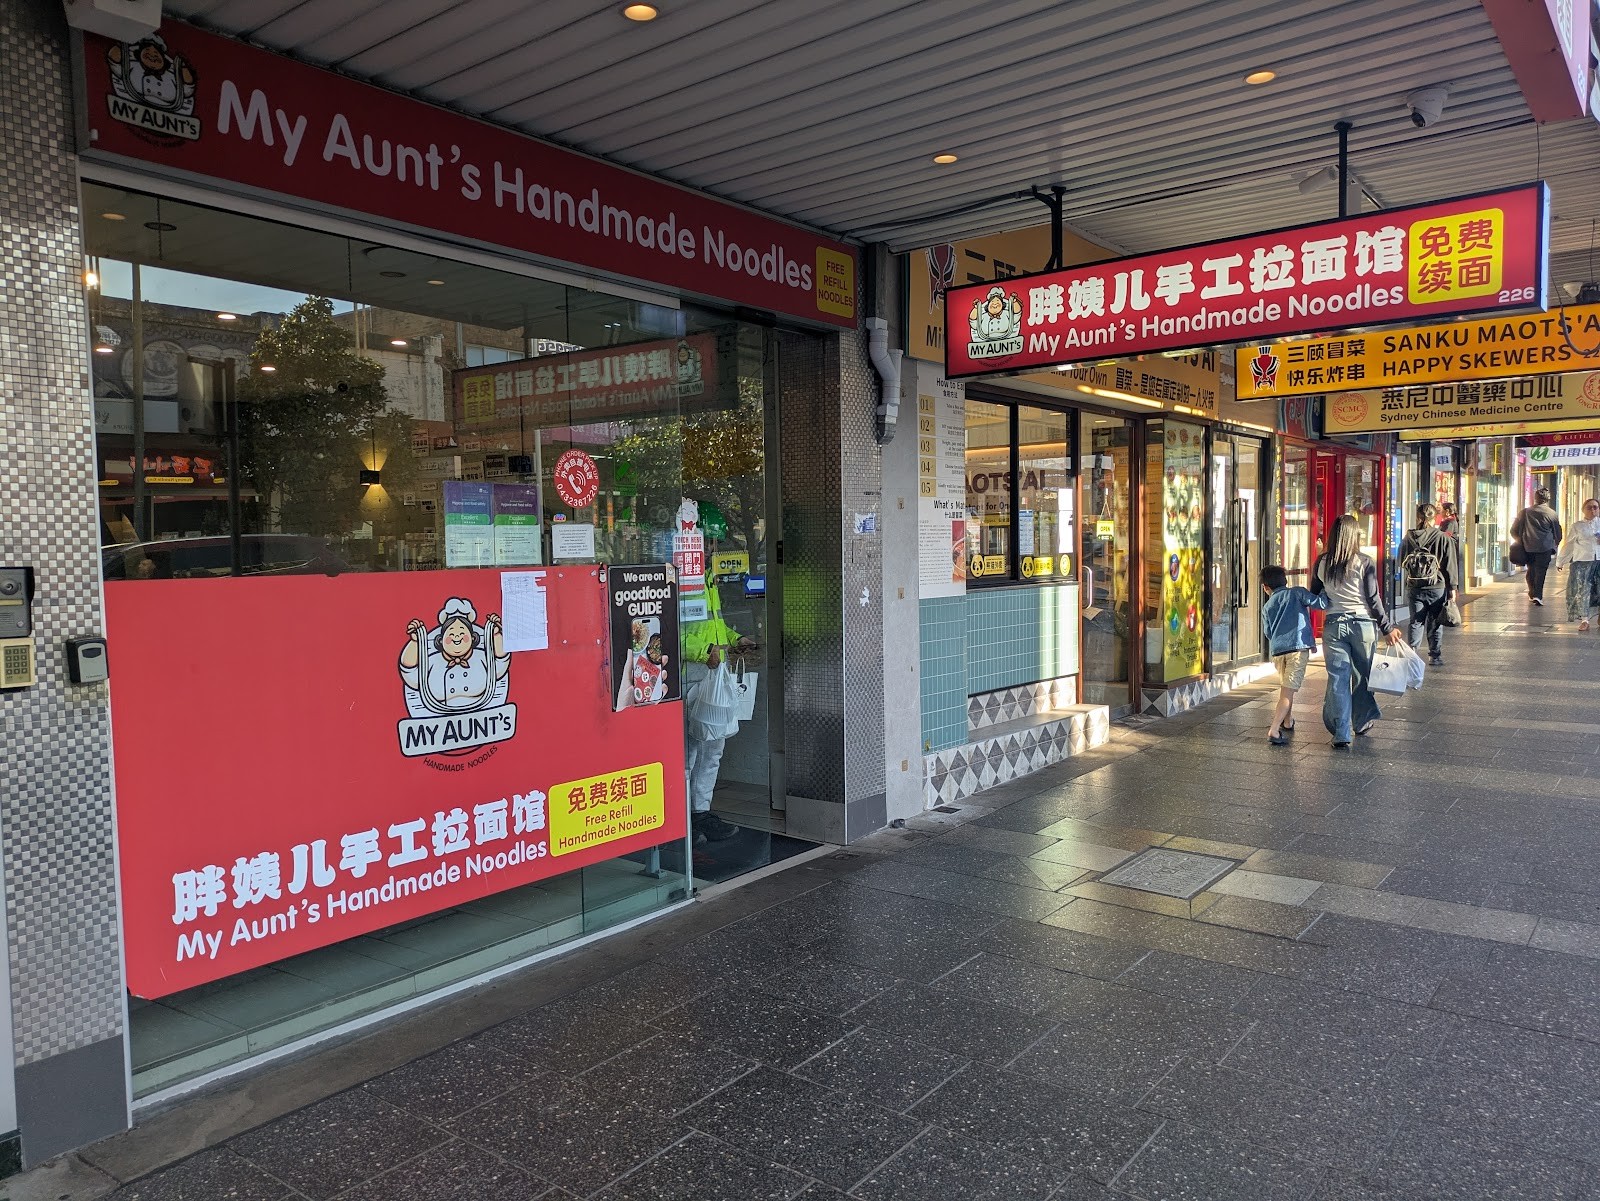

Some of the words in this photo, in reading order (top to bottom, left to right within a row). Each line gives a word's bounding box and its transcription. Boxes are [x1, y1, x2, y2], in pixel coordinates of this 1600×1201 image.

[112, 100, 138, 121] MY
[217, 80, 308, 166] My
[323, 113, 482, 201] Aunt's
[494, 161, 696, 259] Handmade
[703, 225, 813, 291] Noodles
[1418, 219, 1494, 260] 免费
[826, 260, 845, 276] FREE
[1028, 225, 1407, 326] 胖姨儿手工拉面馆
[1417, 255, 1492, 295] 续面
[823, 275, 849, 291] REFILL
[818, 289, 853, 307] NOODLES
[1498, 286, 1535, 303] 226
[1028, 333, 1060, 356] My
[1065, 318, 1136, 348] Aunt's
[1142, 299, 1281, 339] Handmade
[1289, 283, 1404, 319] Noodles
[970, 344, 986, 356] MY
[1287, 339, 1366, 364] 三顾冒菜
[1383, 328, 1469, 354] SANKU
[1382, 354, 1453, 377] HAPPY
[1459, 344, 1571, 369] SKEWERS
[936, 377, 949, 388] How
[1089, 366, 1107, 386] Own
[1287, 364, 1366, 387] 快乐炸串
[921, 399, 929, 410] 01
[1338, 405, 1362, 413] SCMC
[1381, 412, 1419, 423] Sydney
[1423, 409, 1466, 419] Chinese
[1470, 405, 1520, 416] Medicine
[1524, 402, 1563, 412] Centre
[921, 420, 930, 431] 02
[921, 441, 930, 452] 03
[555, 455, 567, 477] PHONE
[567, 450, 585, 459] ORDER
[585, 455, 595, 471] PICK
[592, 471, 599, 480] UP
[921, 461, 930, 473] 04
[556, 484, 598, 507] 0432367226
[921, 482, 931, 493] 05
[720, 559, 742, 570] OPEN
[624, 572, 637, 583] We
[637, 573, 652, 583] are
[654, 572, 664, 582] on
[615, 585, 671, 606] goodfood
[628, 601, 662, 616] GUIDE
[406, 724, 438, 749] MY
[423, 756, 465, 772] HANDMADE
[467, 744, 498, 769] NOODLES
[568, 773, 648, 815] 免费续面
[585, 811, 606, 827] Free
[608, 803, 634, 821] Refill
[559, 824, 616, 849] Handmade
[617, 813, 657, 836] Noodles
[172, 788, 547, 925] 胖姨儿手工拉面馆
[176, 932, 222, 963] My
[230, 898, 320, 946] Aunt's
[327, 866, 460, 918] Handmade
[466, 839, 548, 879] Noodles
